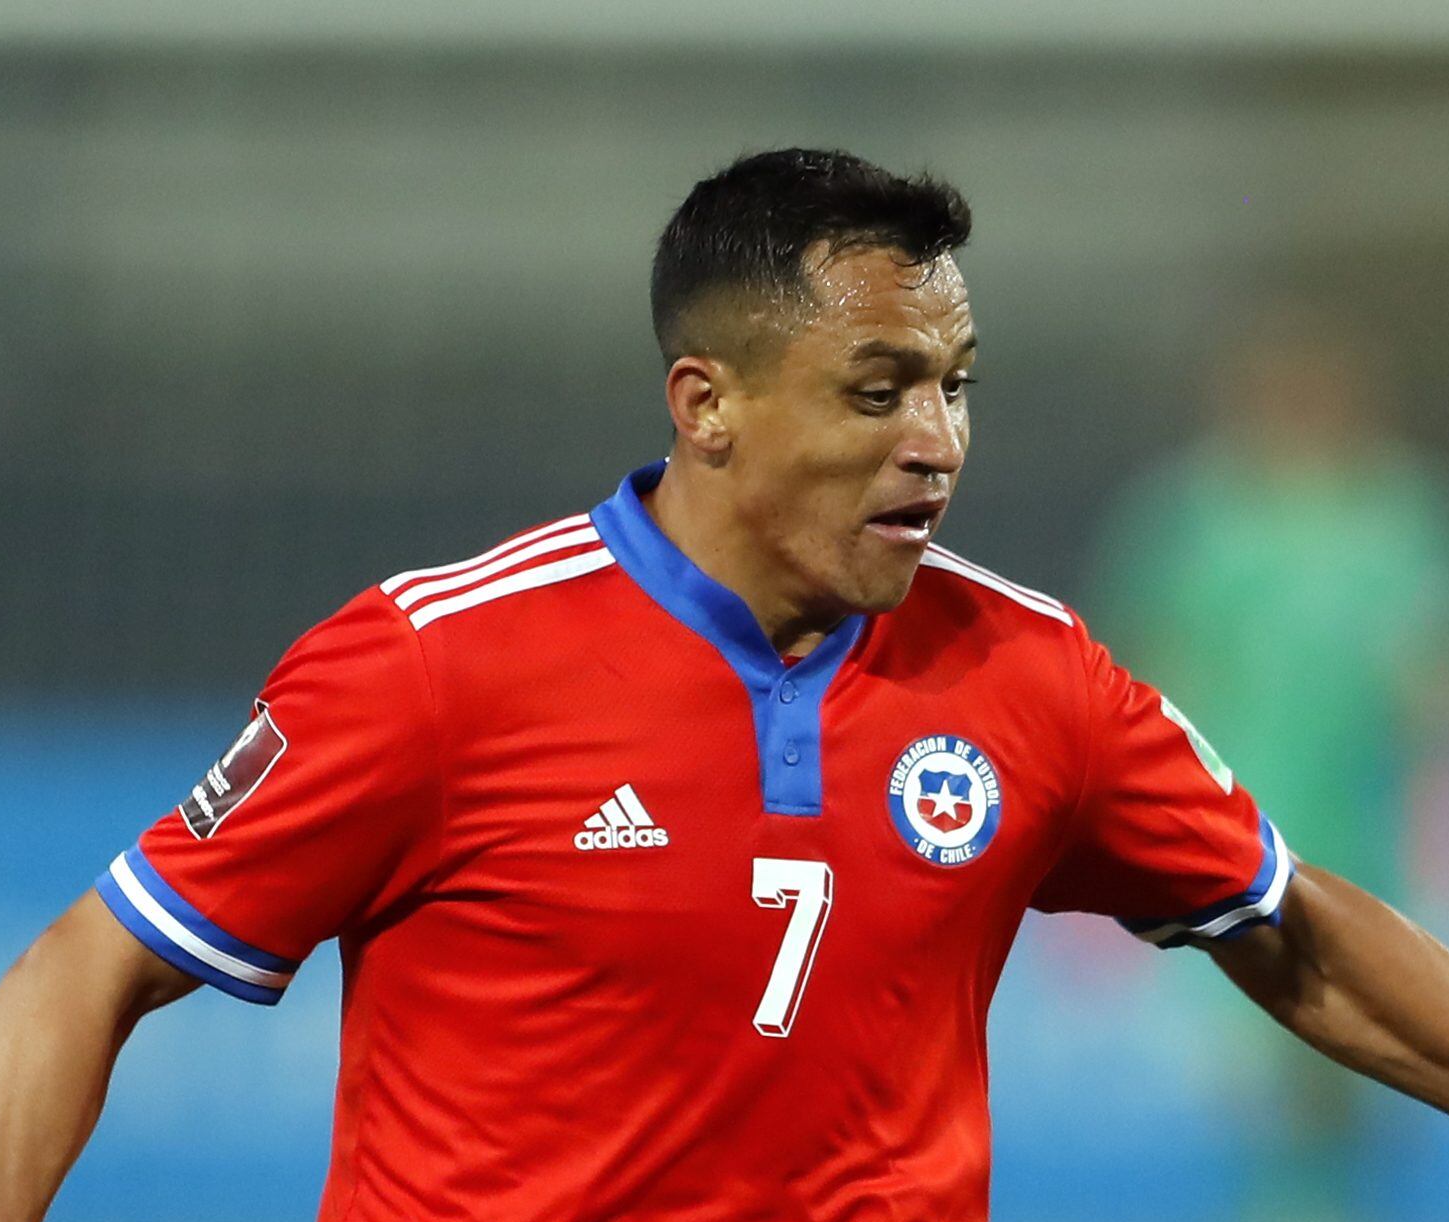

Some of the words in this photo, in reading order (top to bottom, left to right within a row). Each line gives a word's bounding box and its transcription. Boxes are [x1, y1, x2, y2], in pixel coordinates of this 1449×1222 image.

[889, 736, 947, 796] FEDERACION
[954, 740, 972, 759] DE
[972, 755, 1000, 807] FUTBOL
[573, 825, 670, 851] adidas
[916, 839, 936, 859] DE
[940, 844, 974, 864] CHILE
[751, 857, 834, 1038] 7
